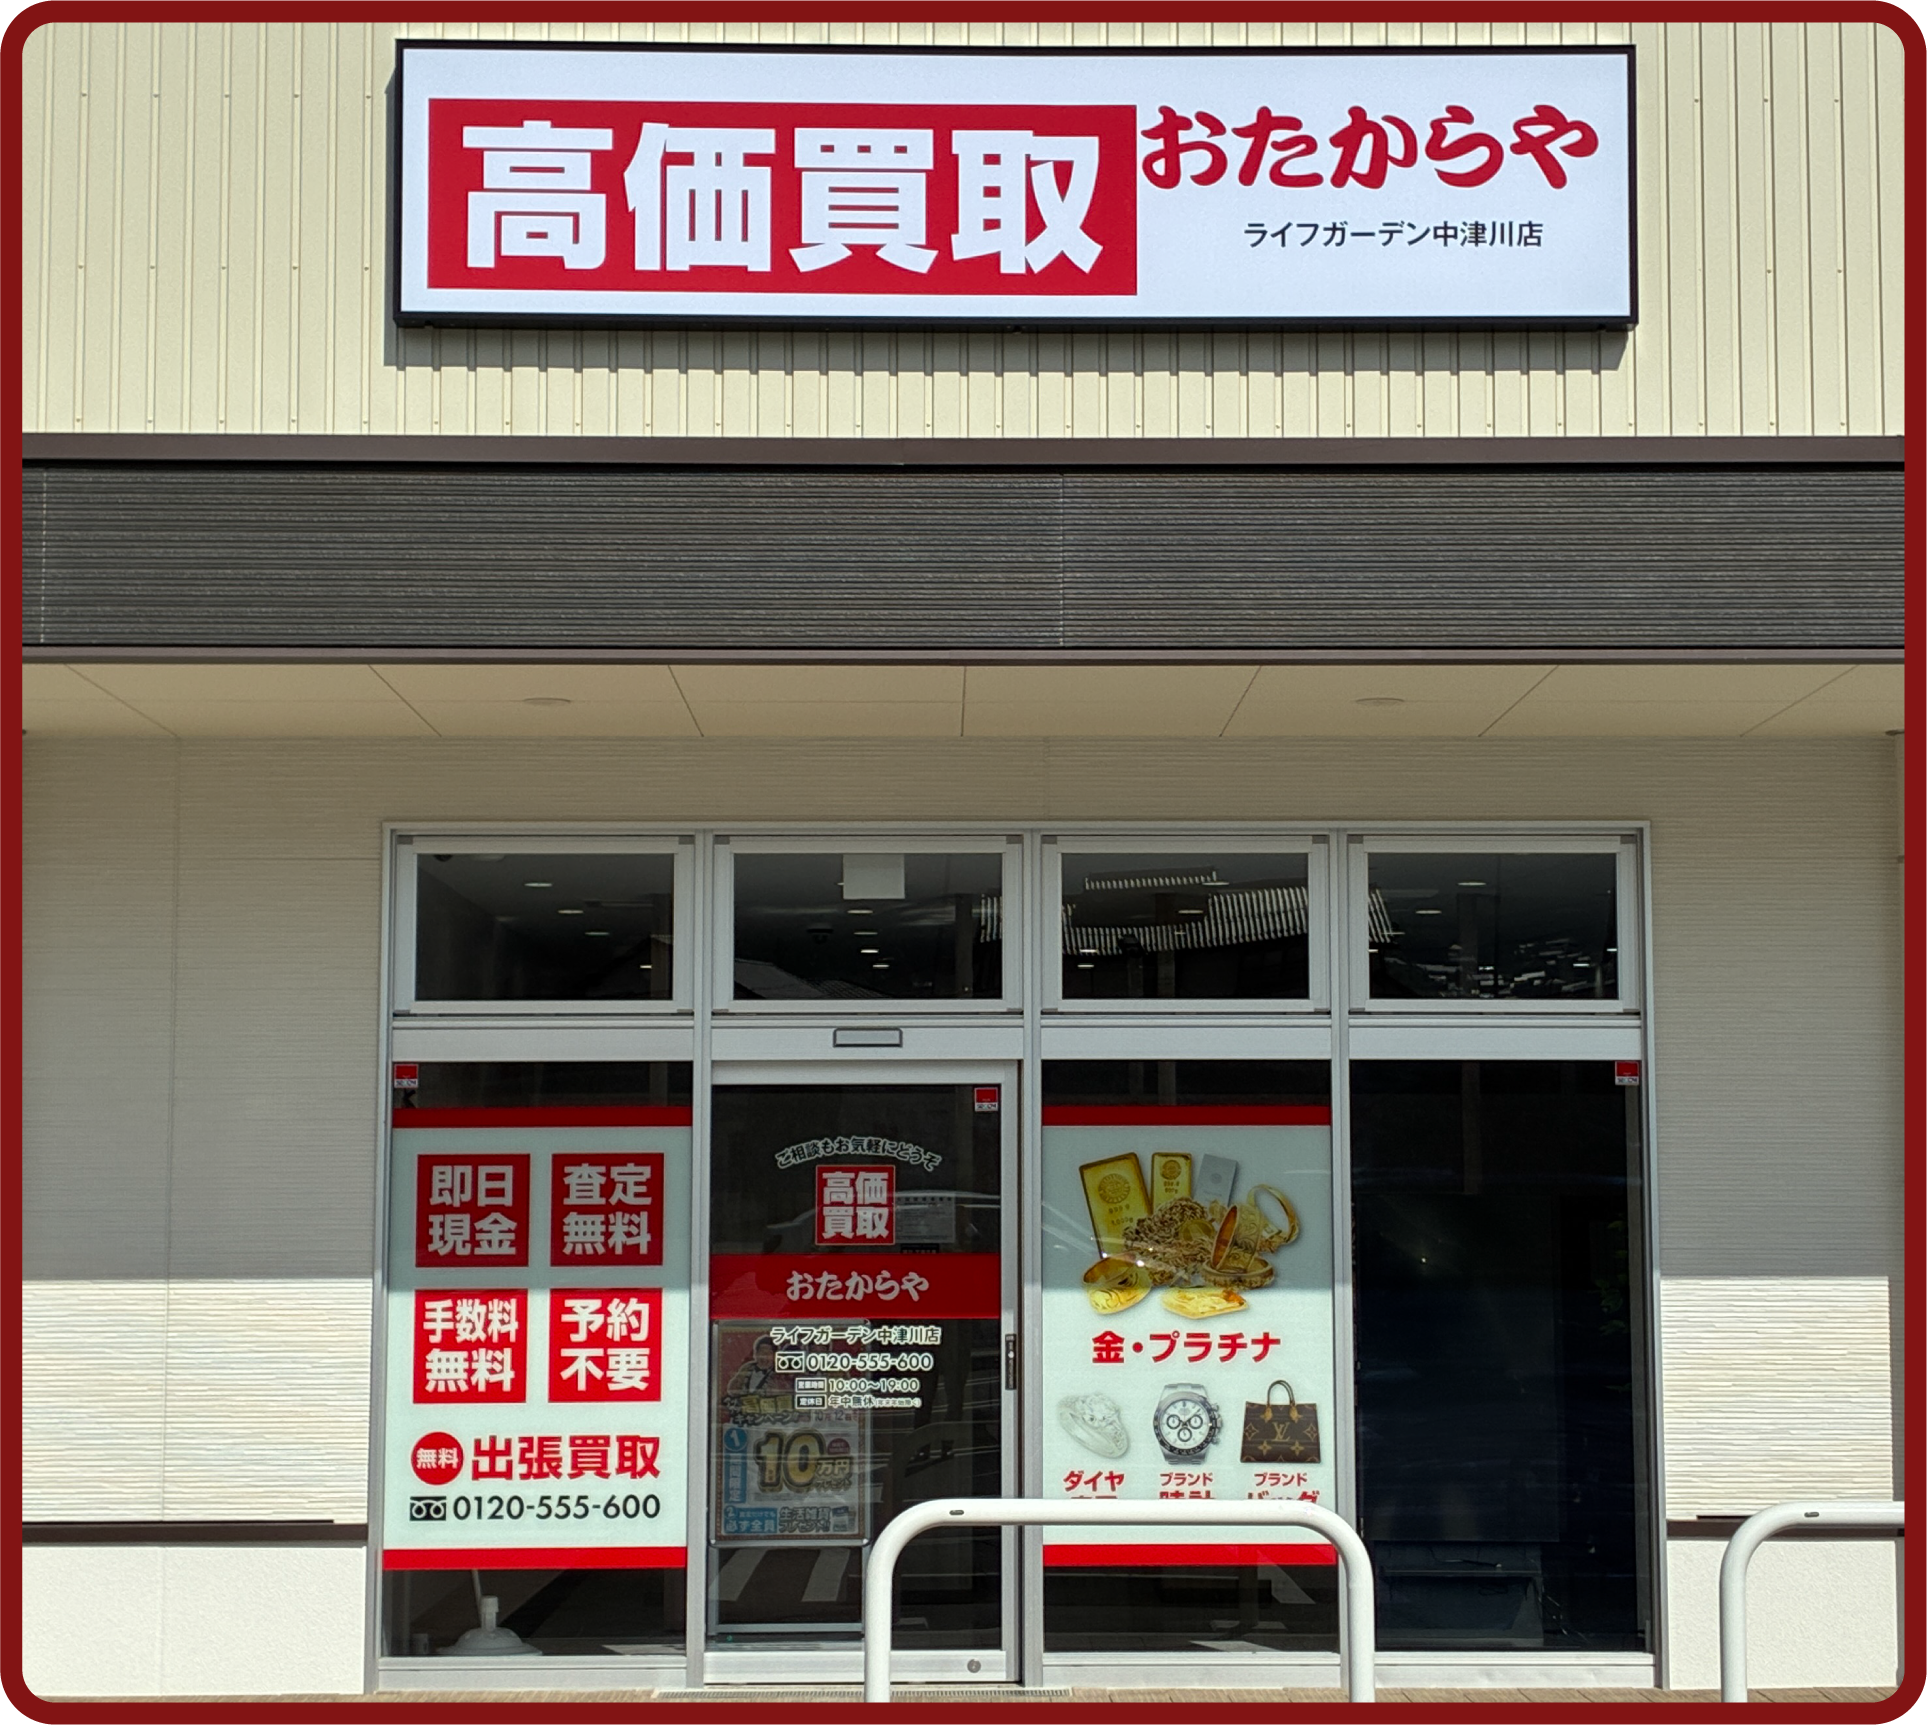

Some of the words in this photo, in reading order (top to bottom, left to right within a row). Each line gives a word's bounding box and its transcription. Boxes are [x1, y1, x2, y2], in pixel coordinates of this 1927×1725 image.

[1141, 104, 1600, 191] おたからや
[462, 119, 1103, 274] 高価買取
[1243, 219, 1544, 251] ライフガーデン中津川店
[776, 1136, 943, 1172] ご相談もお気軽にどうぞ
[430, 1164, 514, 1208] 即日
[563, 1163, 652, 1206] 査定
[822, 1171, 889, 1205] 高価
[429, 1211, 517, 1256] 現金
[562, 1211, 651, 1255] 無料
[822, 1206, 889, 1239] 買取
[786, 1270, 930, 1302] おたからや
[423, 1298, 519, 1343] 手数料
[561, 1298, 649, 1342] 予約
[770, 1325, 942, 1346] ライフガーデン中津川店
[807, 1353, 934, 1371] 0120-555-600
[1092, 1331, 1281, 1364] 金・プラチナ
[425, 1348, 515, 1393] 無料
[561, 1347, 650, 1391] 不要
[416, 1447, 459, 1468] 無料
[471, 1435, 660, 1481] 出張買取
[1063, 1471, 1125, 1492] ダイヤ
[1160, 1473, 1213, 1487] ブランド
[1254, 1473, 1308, 1487] ブランド
[453, 1495, 660, 1521] 0120-555-600
